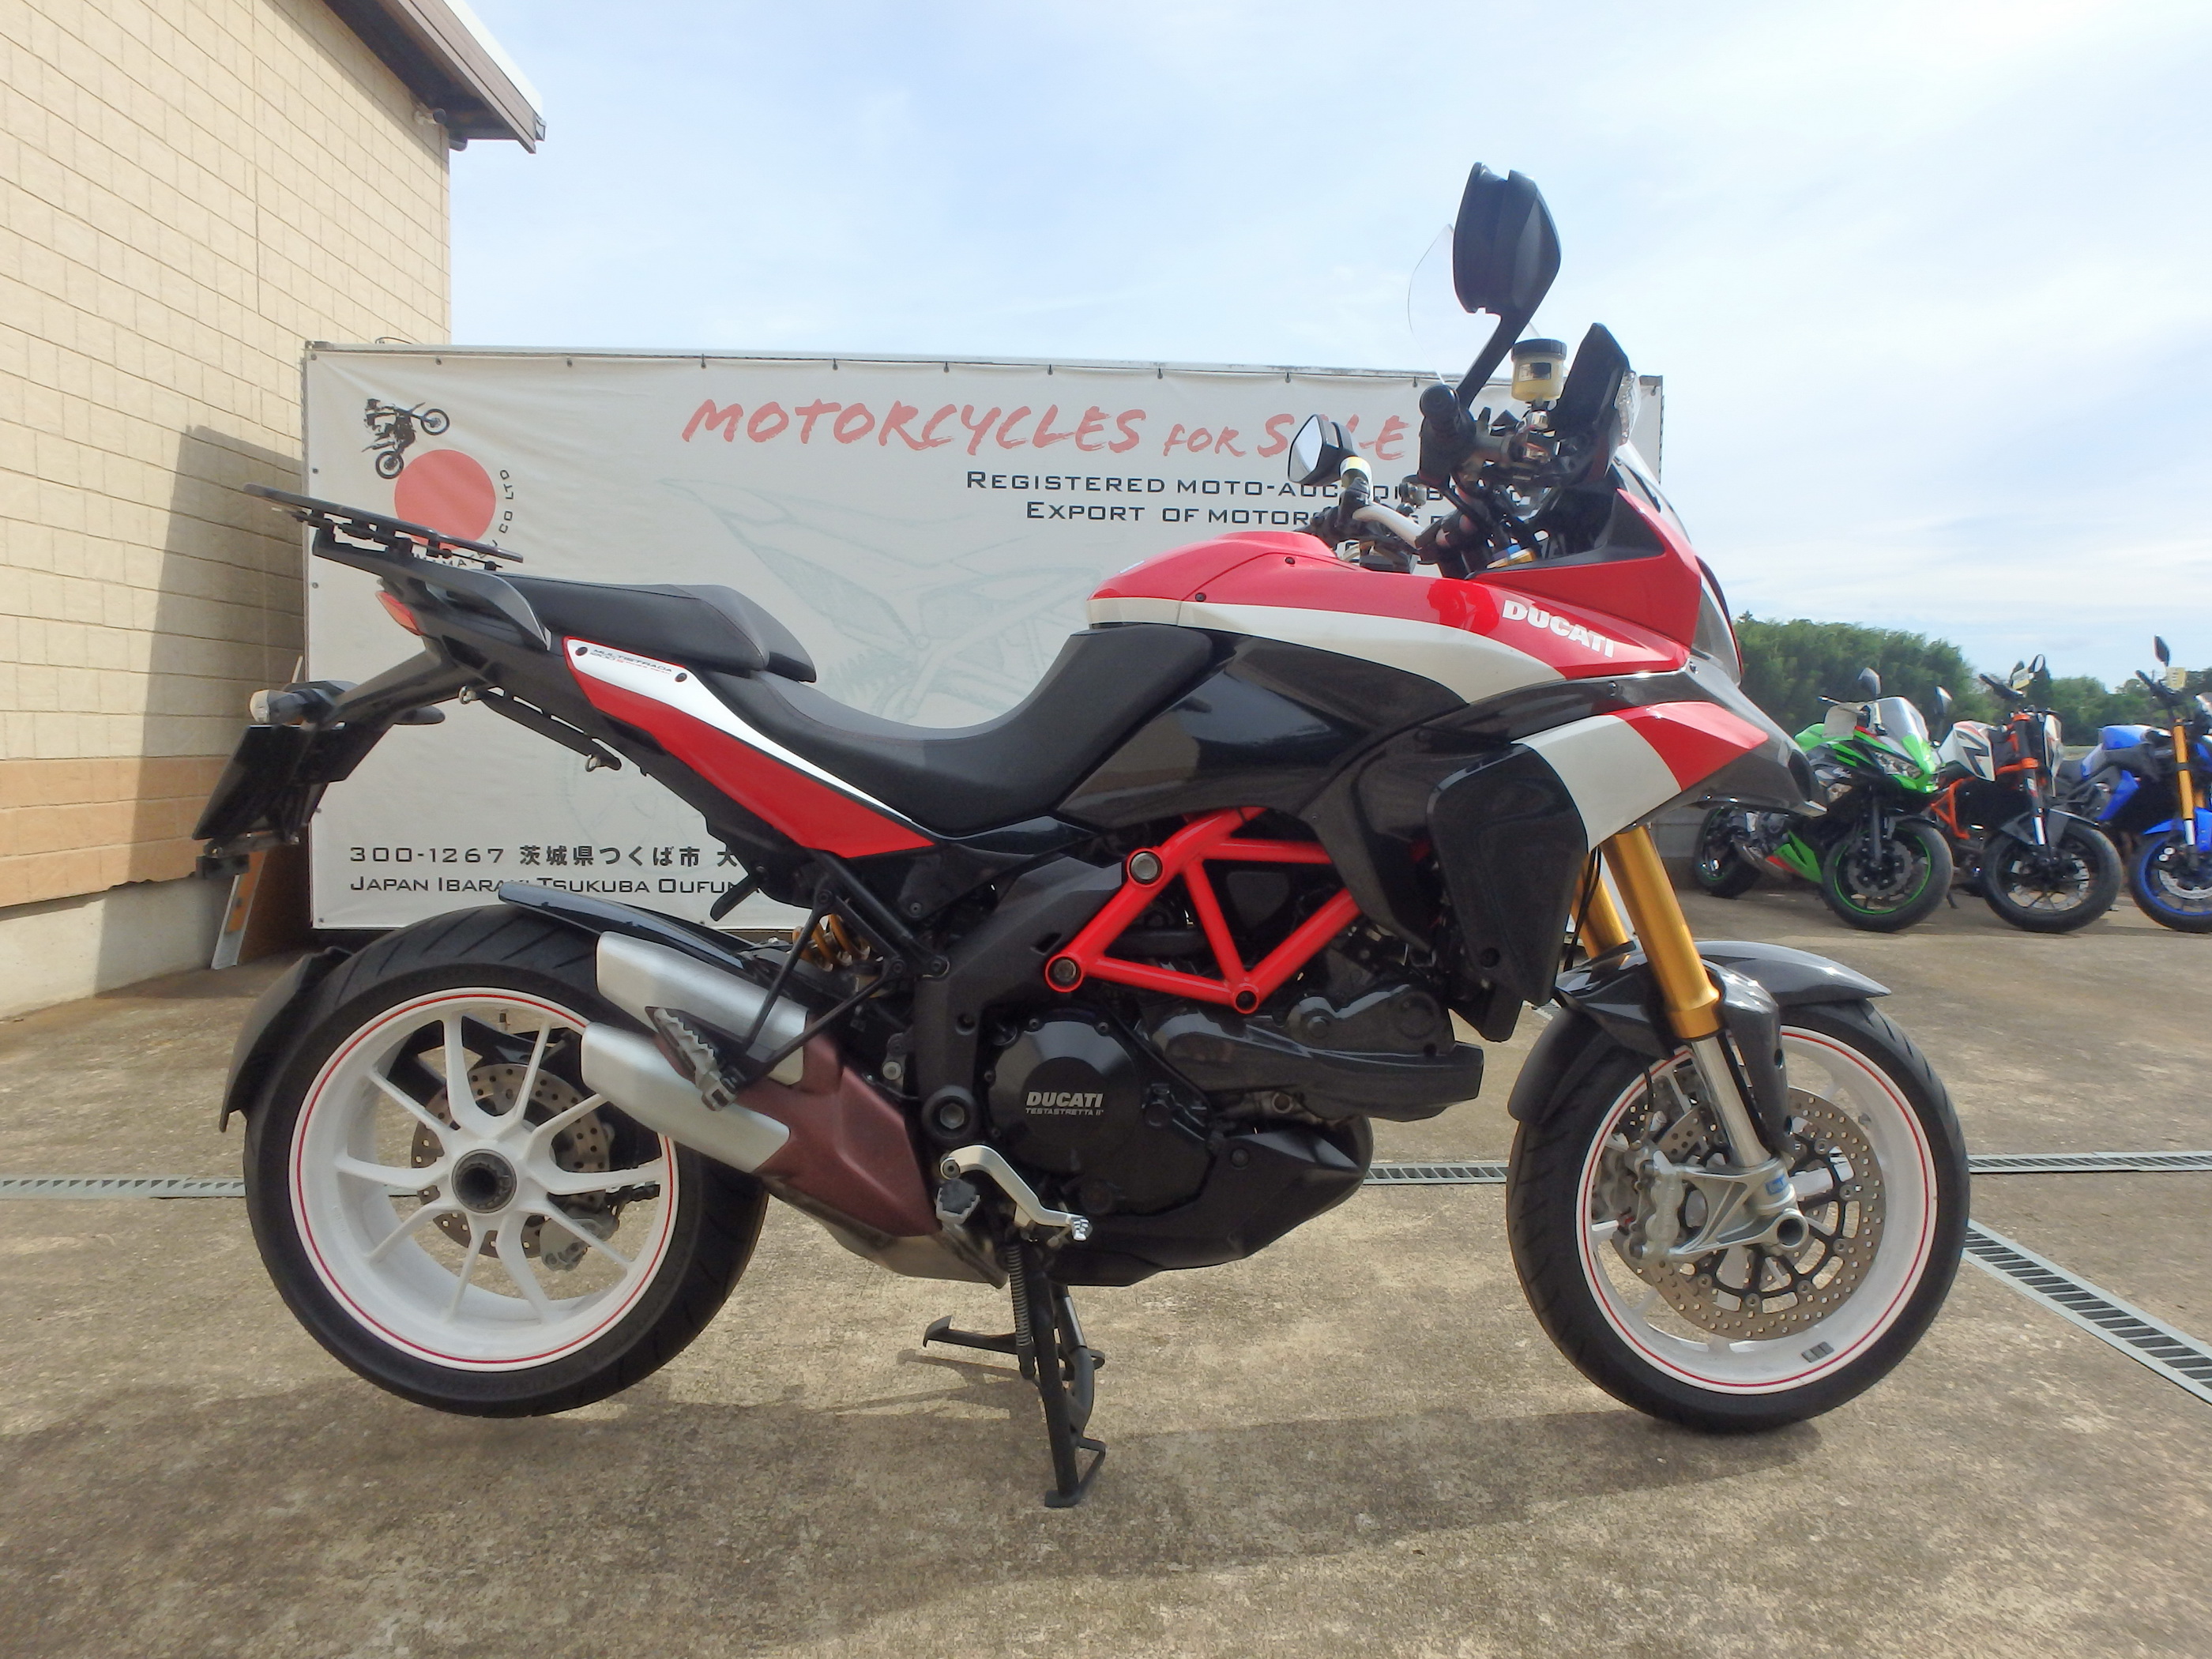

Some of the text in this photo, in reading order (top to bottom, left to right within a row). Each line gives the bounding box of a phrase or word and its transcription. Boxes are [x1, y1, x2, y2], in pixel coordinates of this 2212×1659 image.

[682, 398, 1146, 455] MOTORCYCLES
[1163, 423, 1247, 457] FOR
[967, 471, 1165, 493] REGISTERED
[498, 469, 514, 534] CO LTD
[1027, 501, 1146, 521] EXPORT
[1162, 507, 1199, 522] OF
[1502, 600, 1615, 658] DUCATI
[350, 847, 504, 863] 300-1267
[519, 845, 701, 867] 茨城県つくば市
[350, 876, 429, 892] JAPAN
[1026, 1091, 1104, 1108] DUCATI
